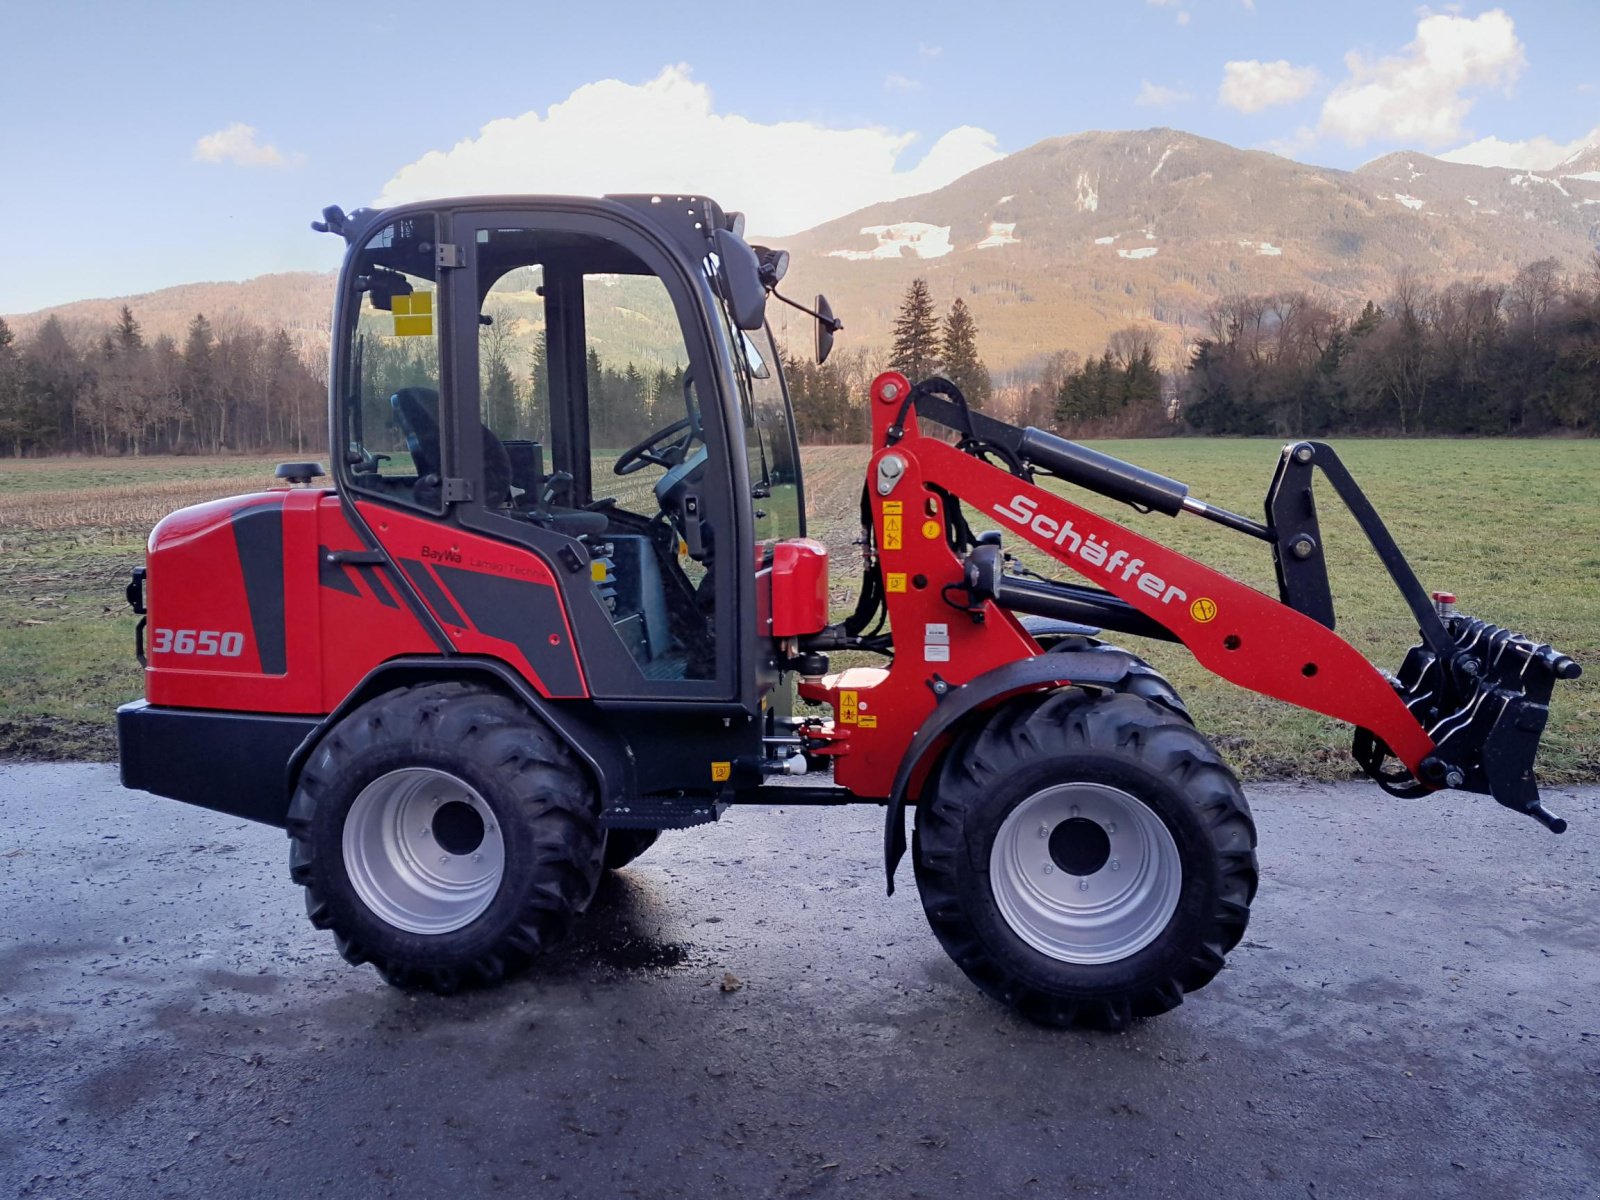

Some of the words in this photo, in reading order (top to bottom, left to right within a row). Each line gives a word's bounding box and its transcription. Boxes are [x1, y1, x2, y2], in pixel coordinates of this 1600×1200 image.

[421, 546, 462, 563] BayWa
[993, 495, 1187, 604] Schäffer
[152, 628, 244, 657] 3650
